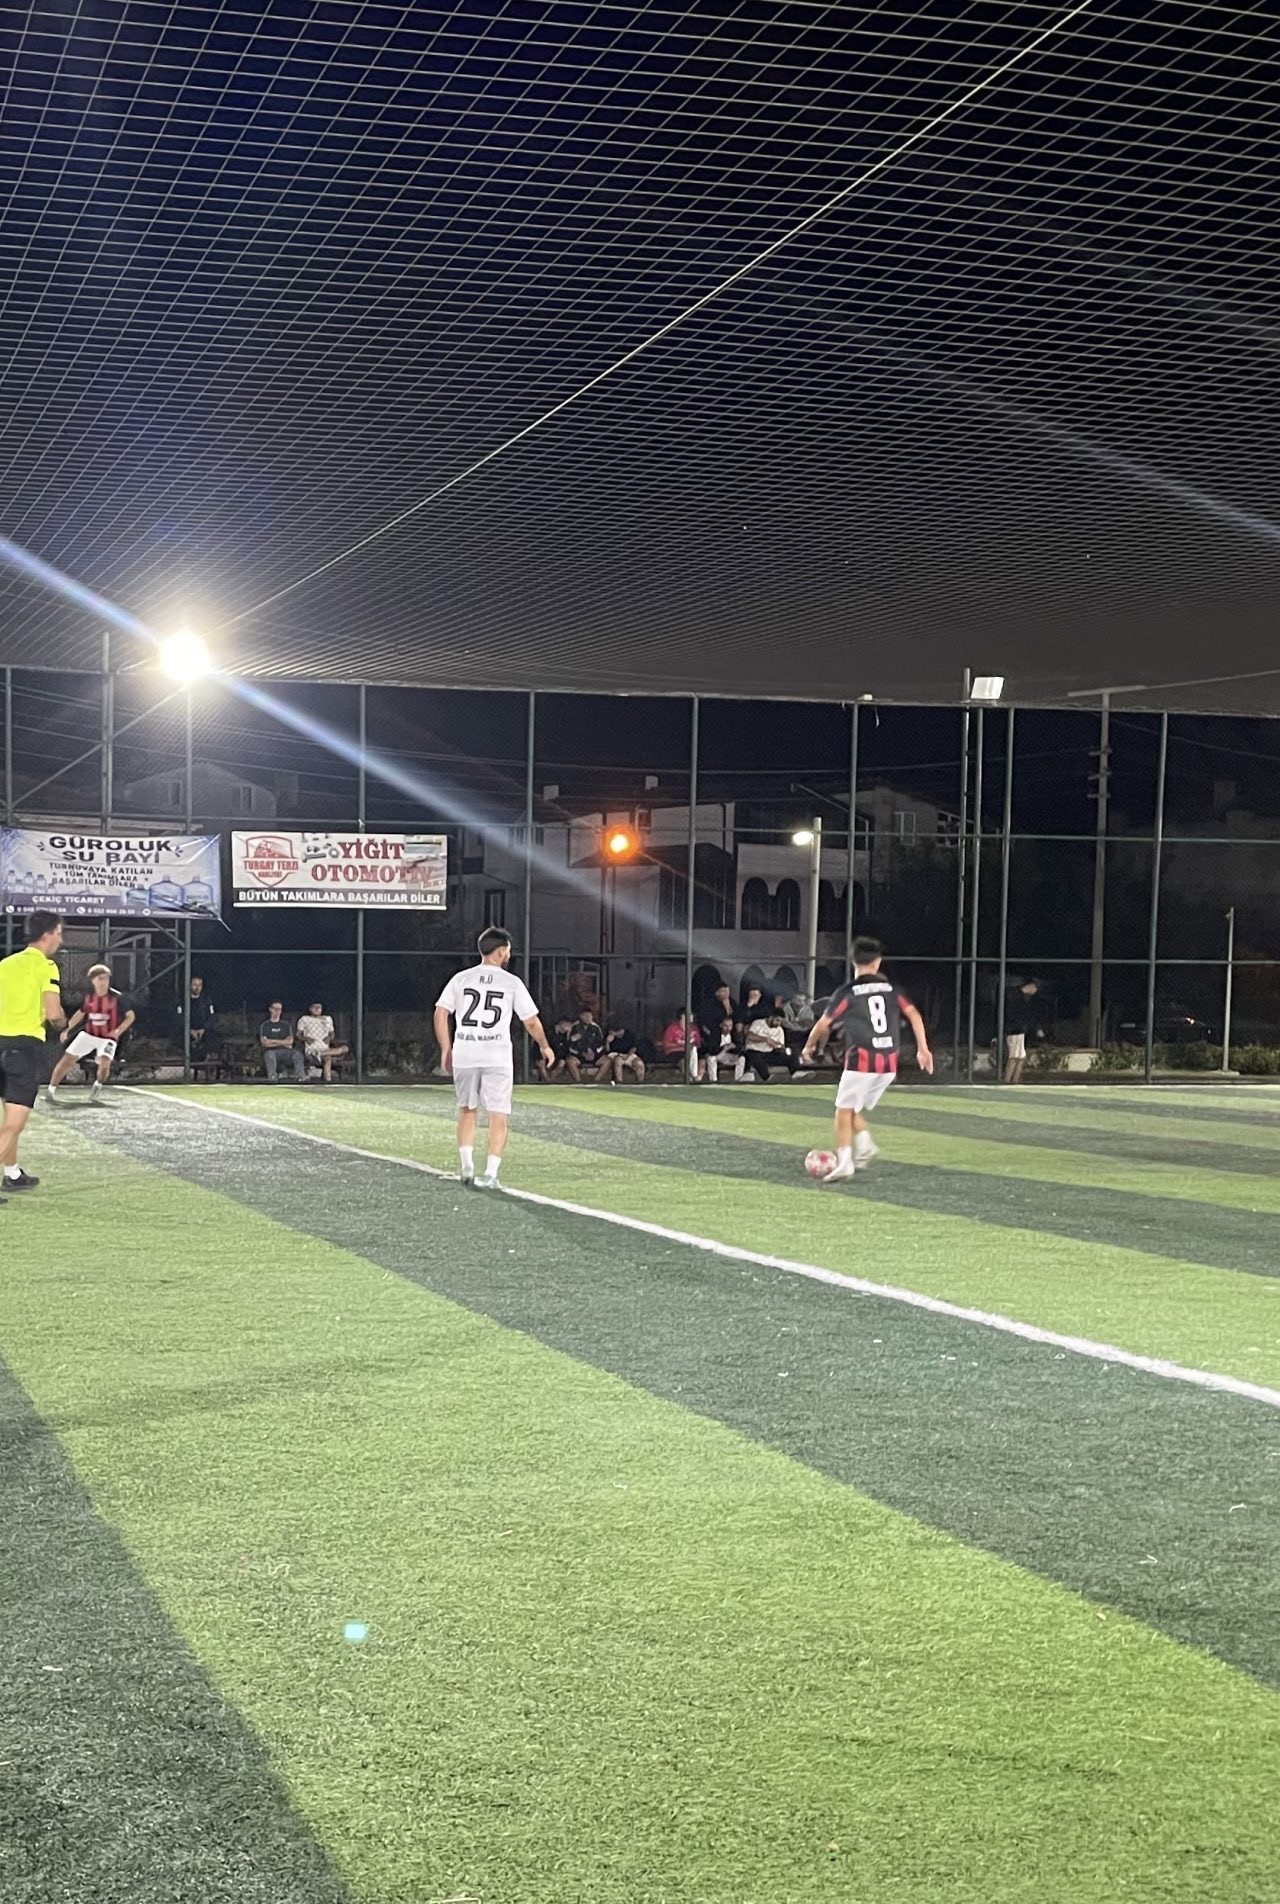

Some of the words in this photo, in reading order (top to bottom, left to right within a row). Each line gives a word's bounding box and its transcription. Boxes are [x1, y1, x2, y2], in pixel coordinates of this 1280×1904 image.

[49, 836, 172, 852] GÜROLUK
[337, 838, 405, 860] YİĞİT
[62, 851, 94, 862] SU
[239, 889, 277, 901] BÜTÜN
[281, 890, 344, 902] TAKIMLARA
[348, 891, 408, 904] BAŞARILAR
[410, 892, 440, 904] DİLER
[461, 988, 505, 1029] 25
[867, 995, 888, 1034] 8
